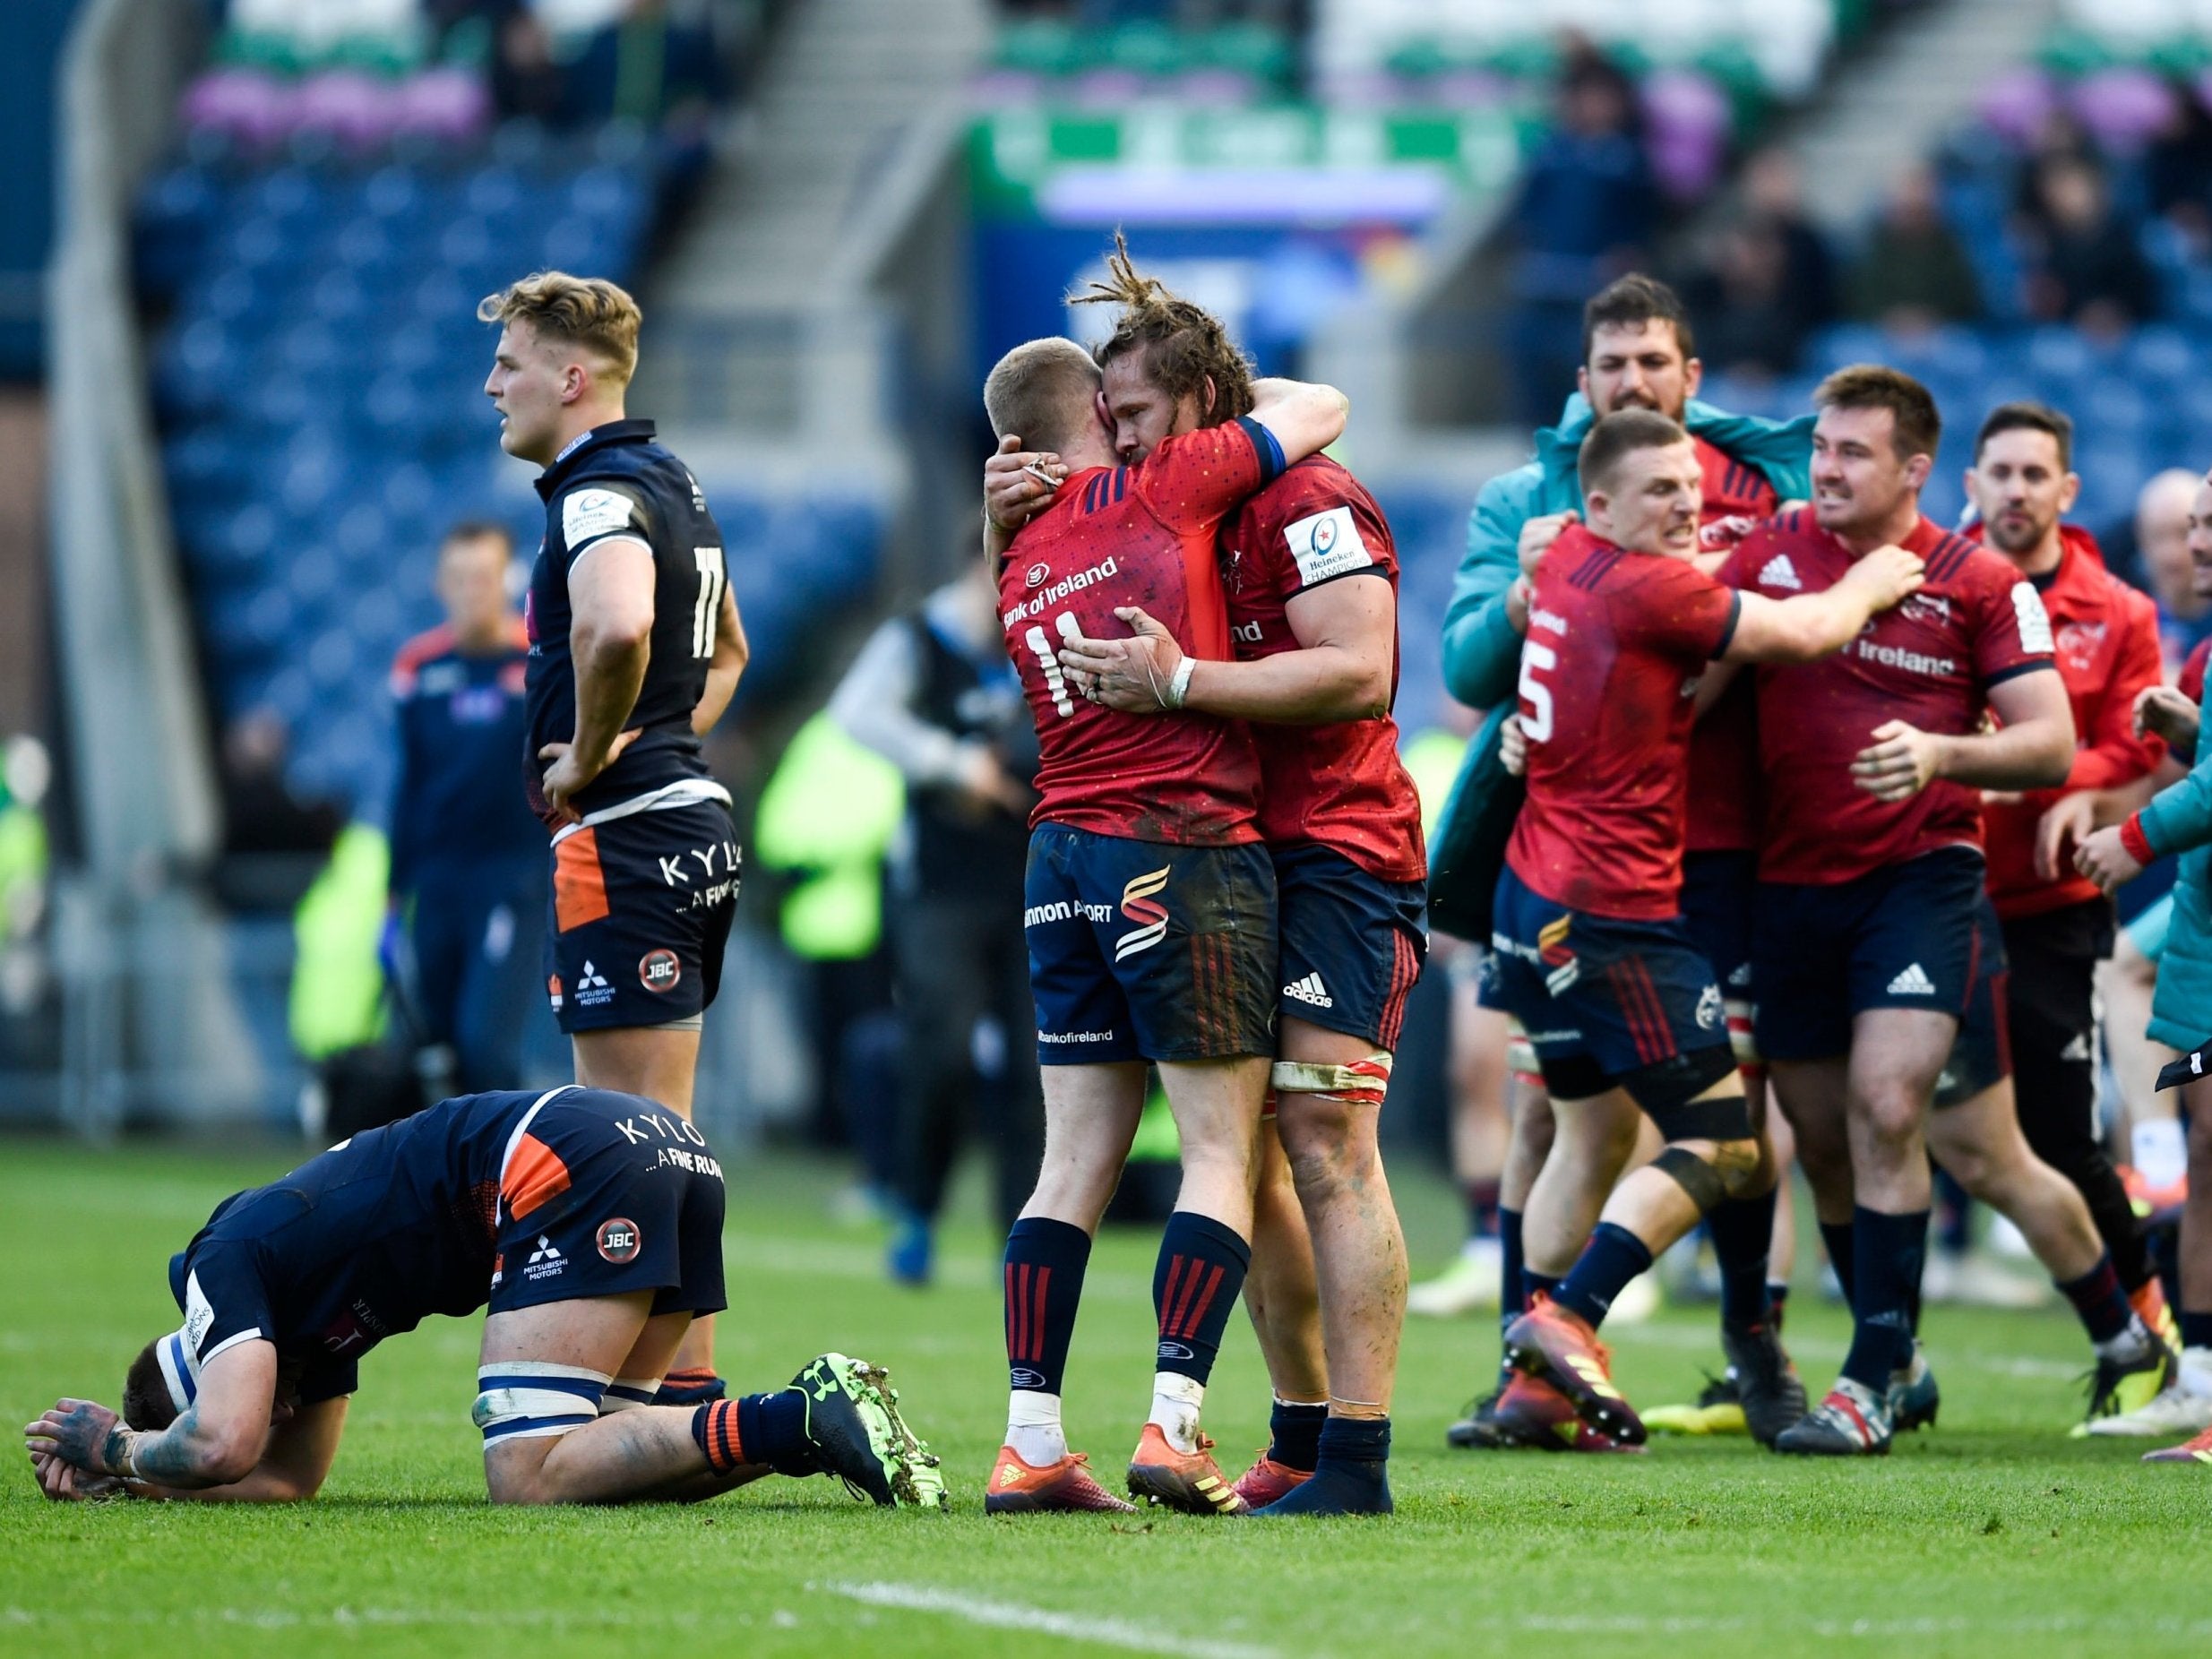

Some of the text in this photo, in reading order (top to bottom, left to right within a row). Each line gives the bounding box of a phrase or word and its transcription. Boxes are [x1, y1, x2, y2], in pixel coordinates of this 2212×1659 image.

[1310, 550, 1355, 571] Heineken
[693, 546, 724, 658] 11
[1003, 556, 1118, 632] ank of Ireland
[1519, 640, 1556, 744] 5
[646, 961, 674, 979] JBC
[575, 988, 615, 1000] MITSUBISHI
[581, 996, 611, 1006] MOTORS
[1283, 986, 1332, 1009] adidas
[615, 1114, 705, 1147] KYLO
[667, 1148, 693, 1172] FINE
[603, 1232, 634, 1249] JBC
[523, 1259, 569, 1275] MITSUBISHI
[529, 1267, 563, 1281] MOTORS
